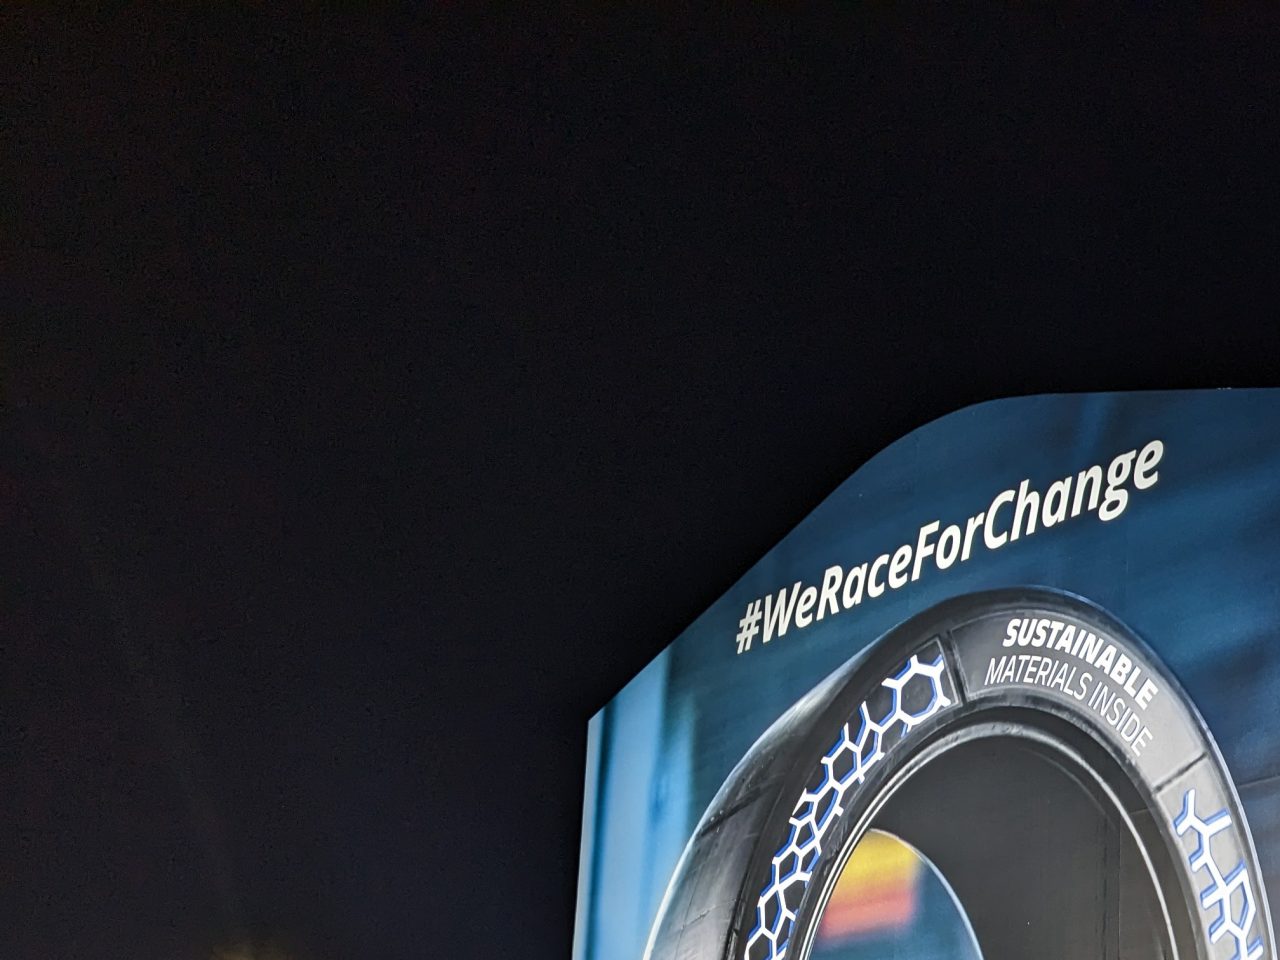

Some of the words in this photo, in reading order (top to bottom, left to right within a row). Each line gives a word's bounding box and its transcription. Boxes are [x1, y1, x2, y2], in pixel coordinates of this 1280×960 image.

[735, 439, 1165, 655] #WeRaceForChange
[984, 654, 1093, 701] MATERIALS
[1088, 681, 1154, 757] INSIDE
[1002, 618, 1159, 710] SUSTAINABLE
